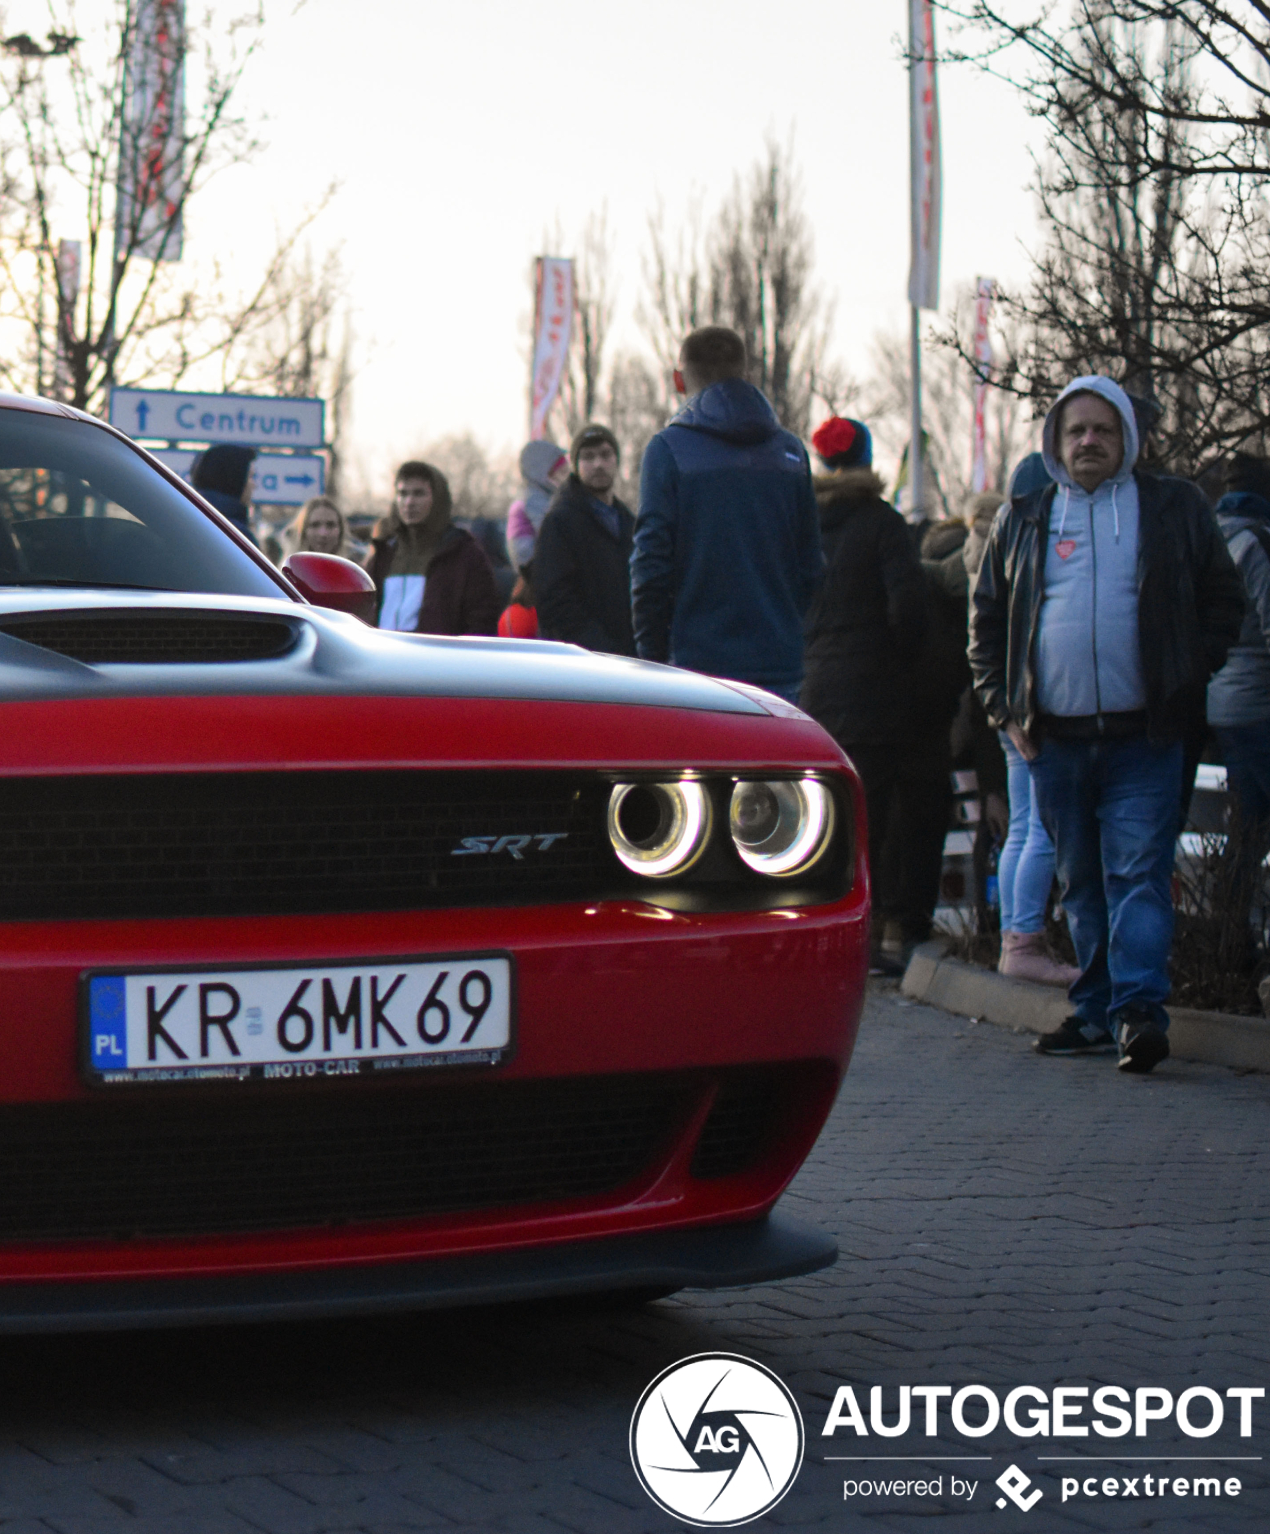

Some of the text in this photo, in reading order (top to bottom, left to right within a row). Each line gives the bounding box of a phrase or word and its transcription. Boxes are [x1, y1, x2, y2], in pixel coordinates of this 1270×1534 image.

[175, 403, 301, 435] Centrum
[450, 832, 569, 860] SRT
[146, 969, 492, 1060] KR 6MK69
[95, 1034, 123, 1056] PL
[264, 1059, 360, 1079] MOTO-CAR
